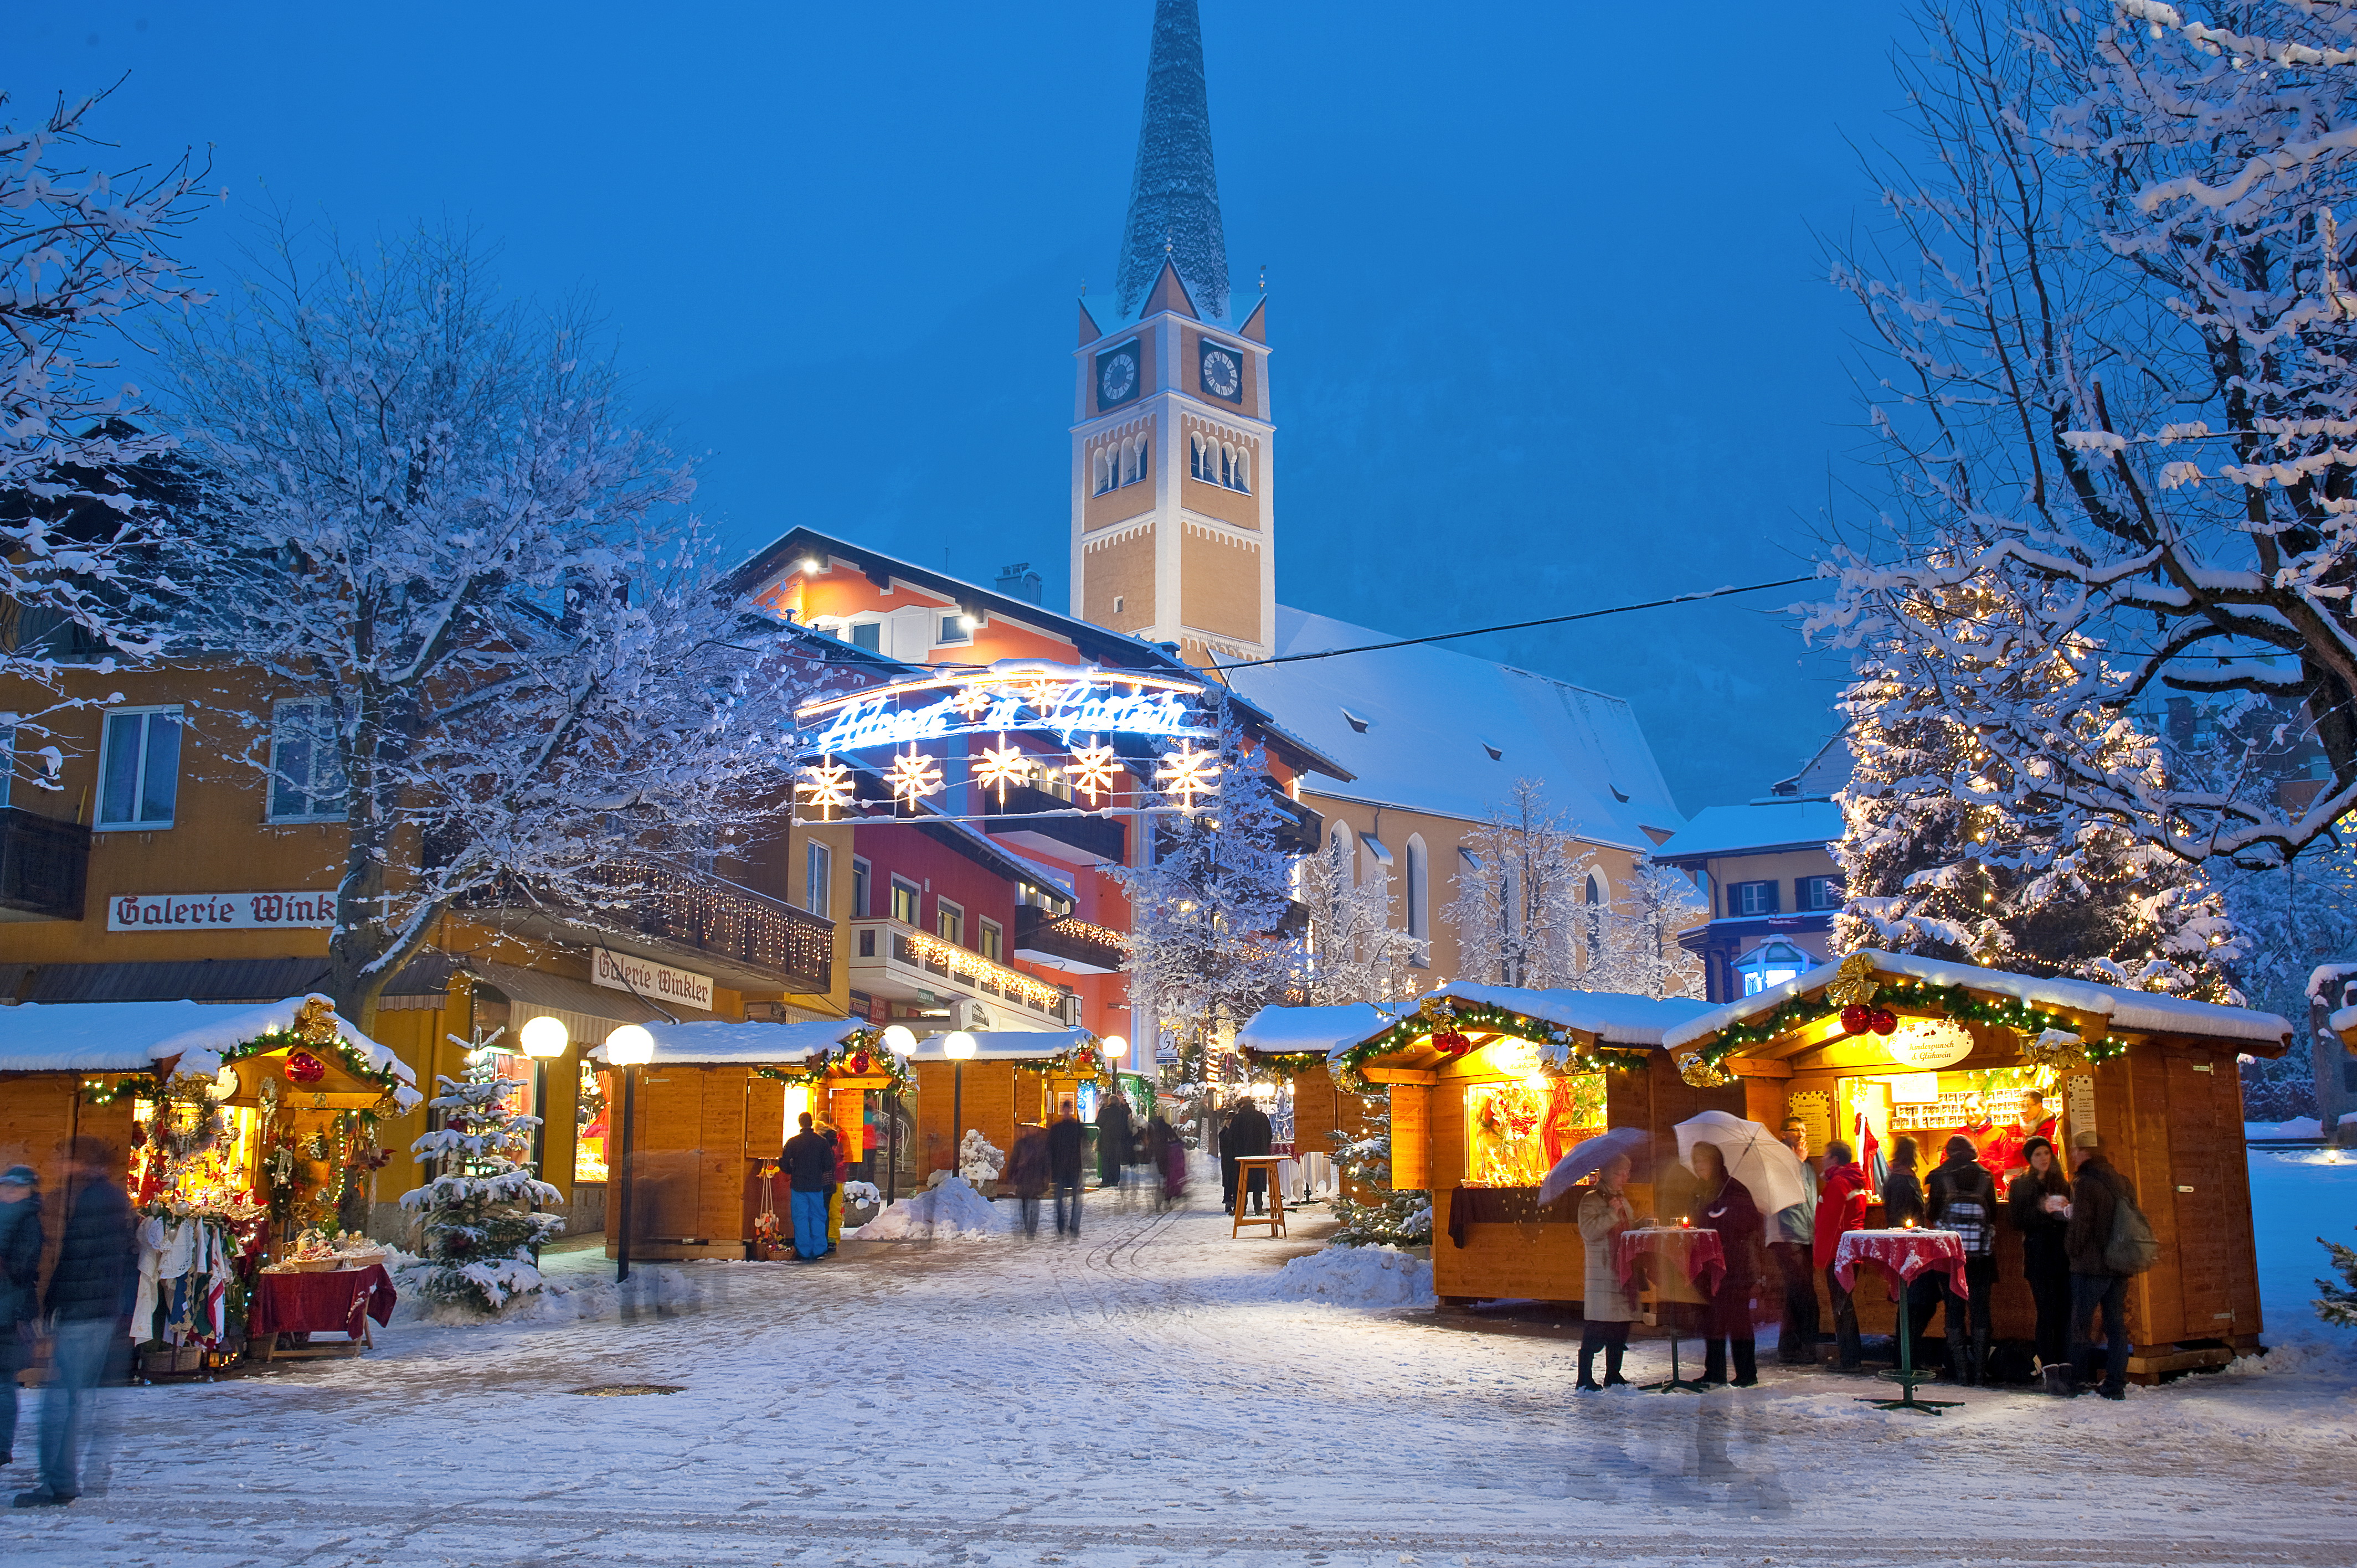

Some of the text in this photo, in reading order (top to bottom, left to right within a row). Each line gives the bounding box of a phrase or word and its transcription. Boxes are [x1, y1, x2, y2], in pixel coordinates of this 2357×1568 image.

[818, 680, 1186, 752] Advent in Gastein
[117, 895, 235, 925] Galerie
[599, 952, 708, 1003] Galerie Winkler
[1908, 1040, 1954, 1051] Kinderpunsch
[1919, 1051, 1952, 1062] Glühwein
